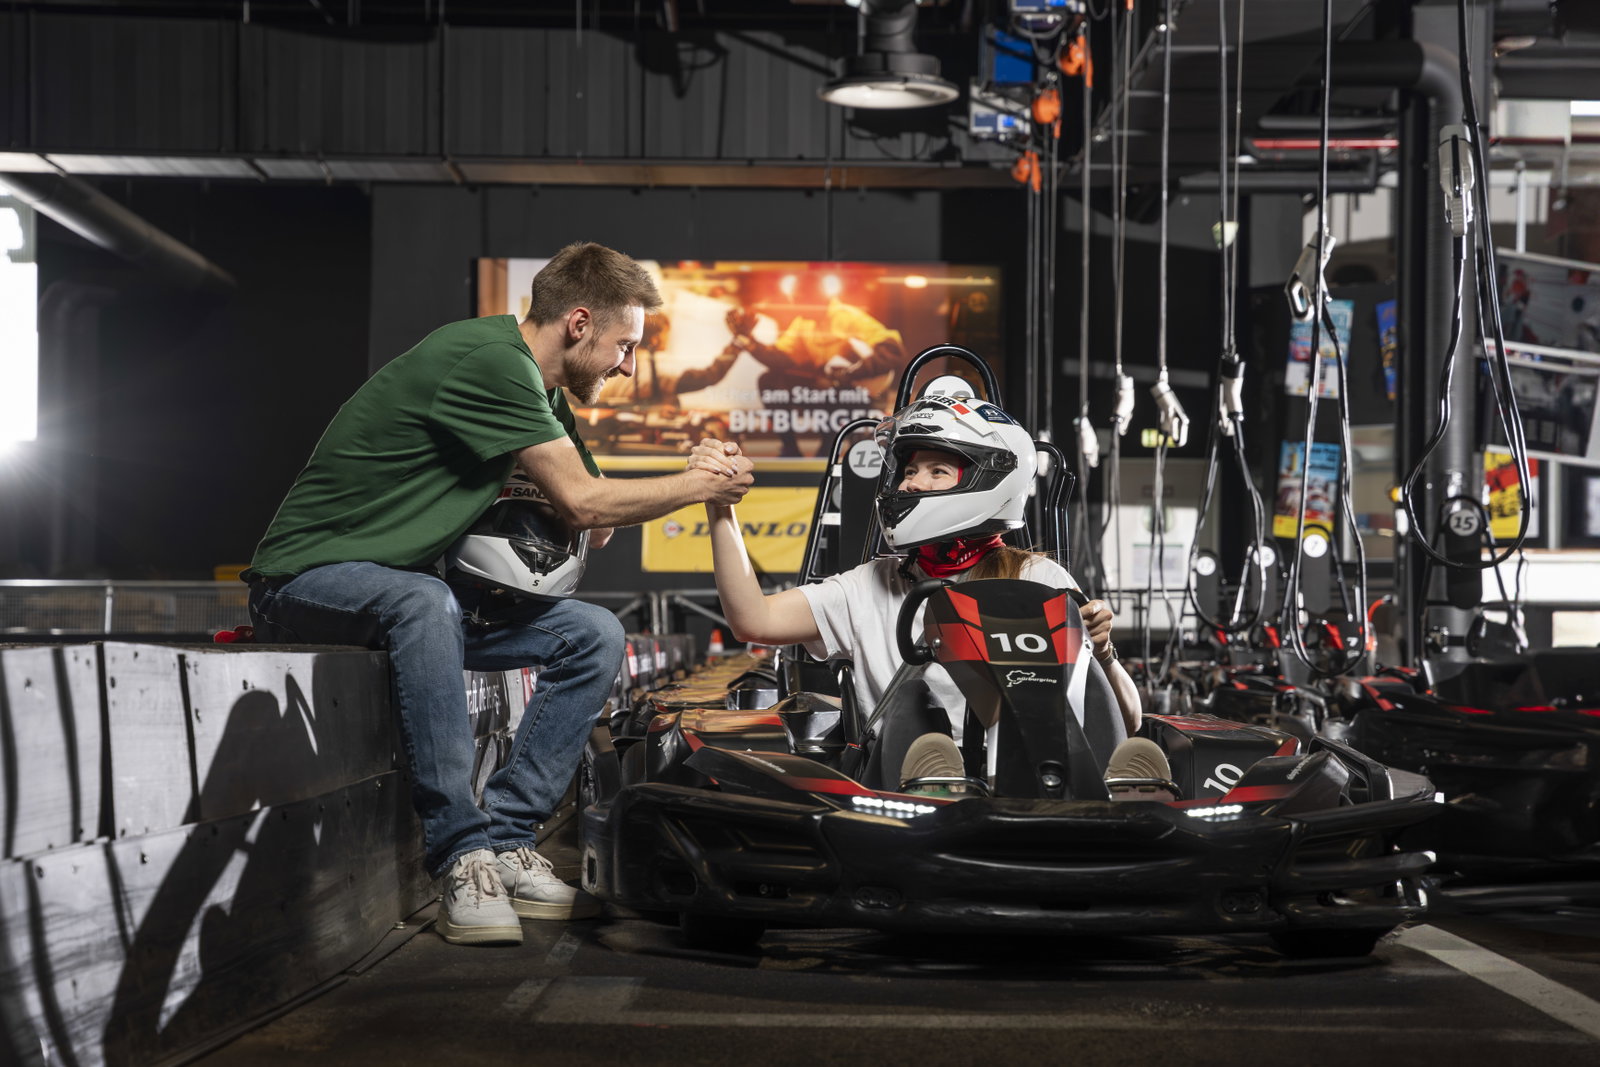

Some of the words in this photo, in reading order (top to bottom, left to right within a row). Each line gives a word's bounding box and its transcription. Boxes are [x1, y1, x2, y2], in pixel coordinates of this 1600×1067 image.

[762, 389, 789, 403] am
[792, 386, 837, 403] Start
[839, 387, 870, 403] mit
[853, 450, 882, 468] 12
[512, 487, 545, 499] SAN
[691, 521, 807, 537] DNLO
[1454, 516, 1474, 530] 15
[532, 579, 540, 587] S
[990, 633, 1048, 653] 10
[1203, 763, 1245, 794] 10
